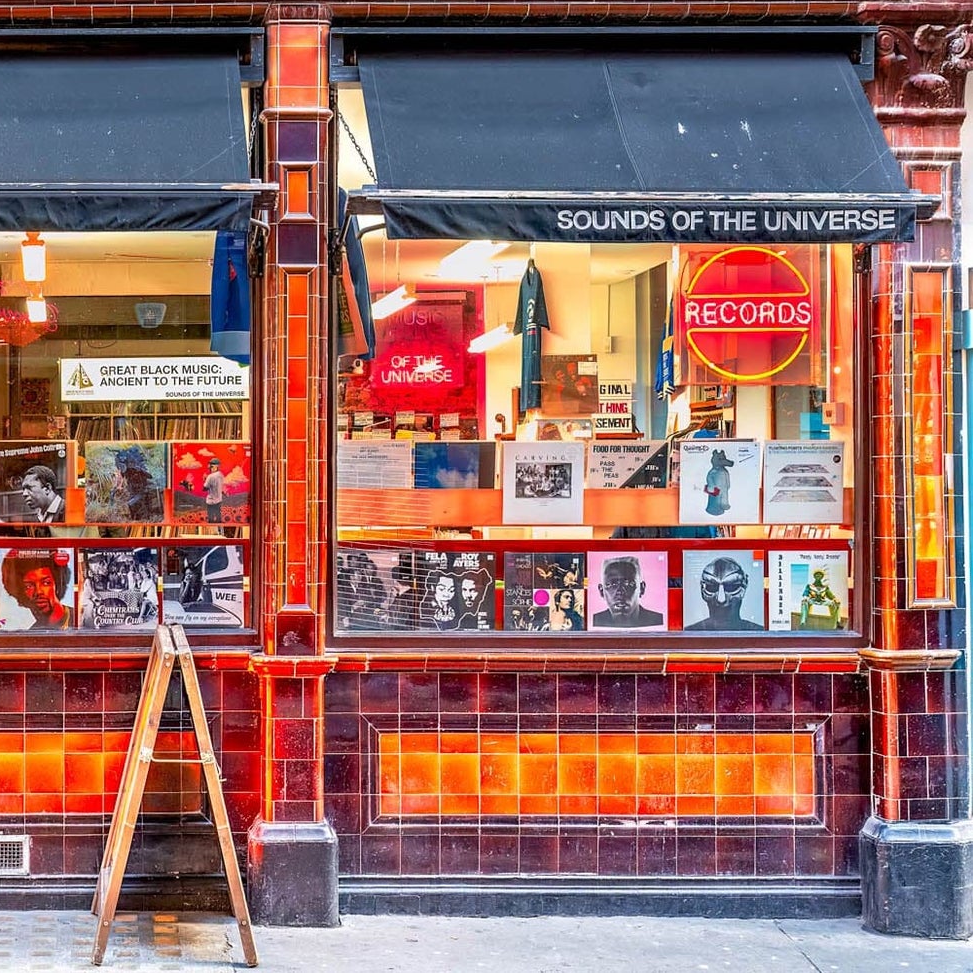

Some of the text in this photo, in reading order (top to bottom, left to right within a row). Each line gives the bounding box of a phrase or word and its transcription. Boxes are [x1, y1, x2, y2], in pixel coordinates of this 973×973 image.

[557, 208, 896, 231] SOUNDS OF THE UNIVERSE
[684, 301, 812, 325] RECORDS
[391, 355, 410, 369] OF
[100, 364, 222, 375] GREAT BLACK MUSIC:
[100, 375, 242, 386] ANCIENT TO THE FUTURE
[381, 369, 453, 383] UNIVERSE
[593, 445, 650, 453] FOOD FOR THOUGHT
[425, 552, 447, 561] FELA
[453, 559, 480, 567] AYERS
[215, 591, 237, 602] WEE
